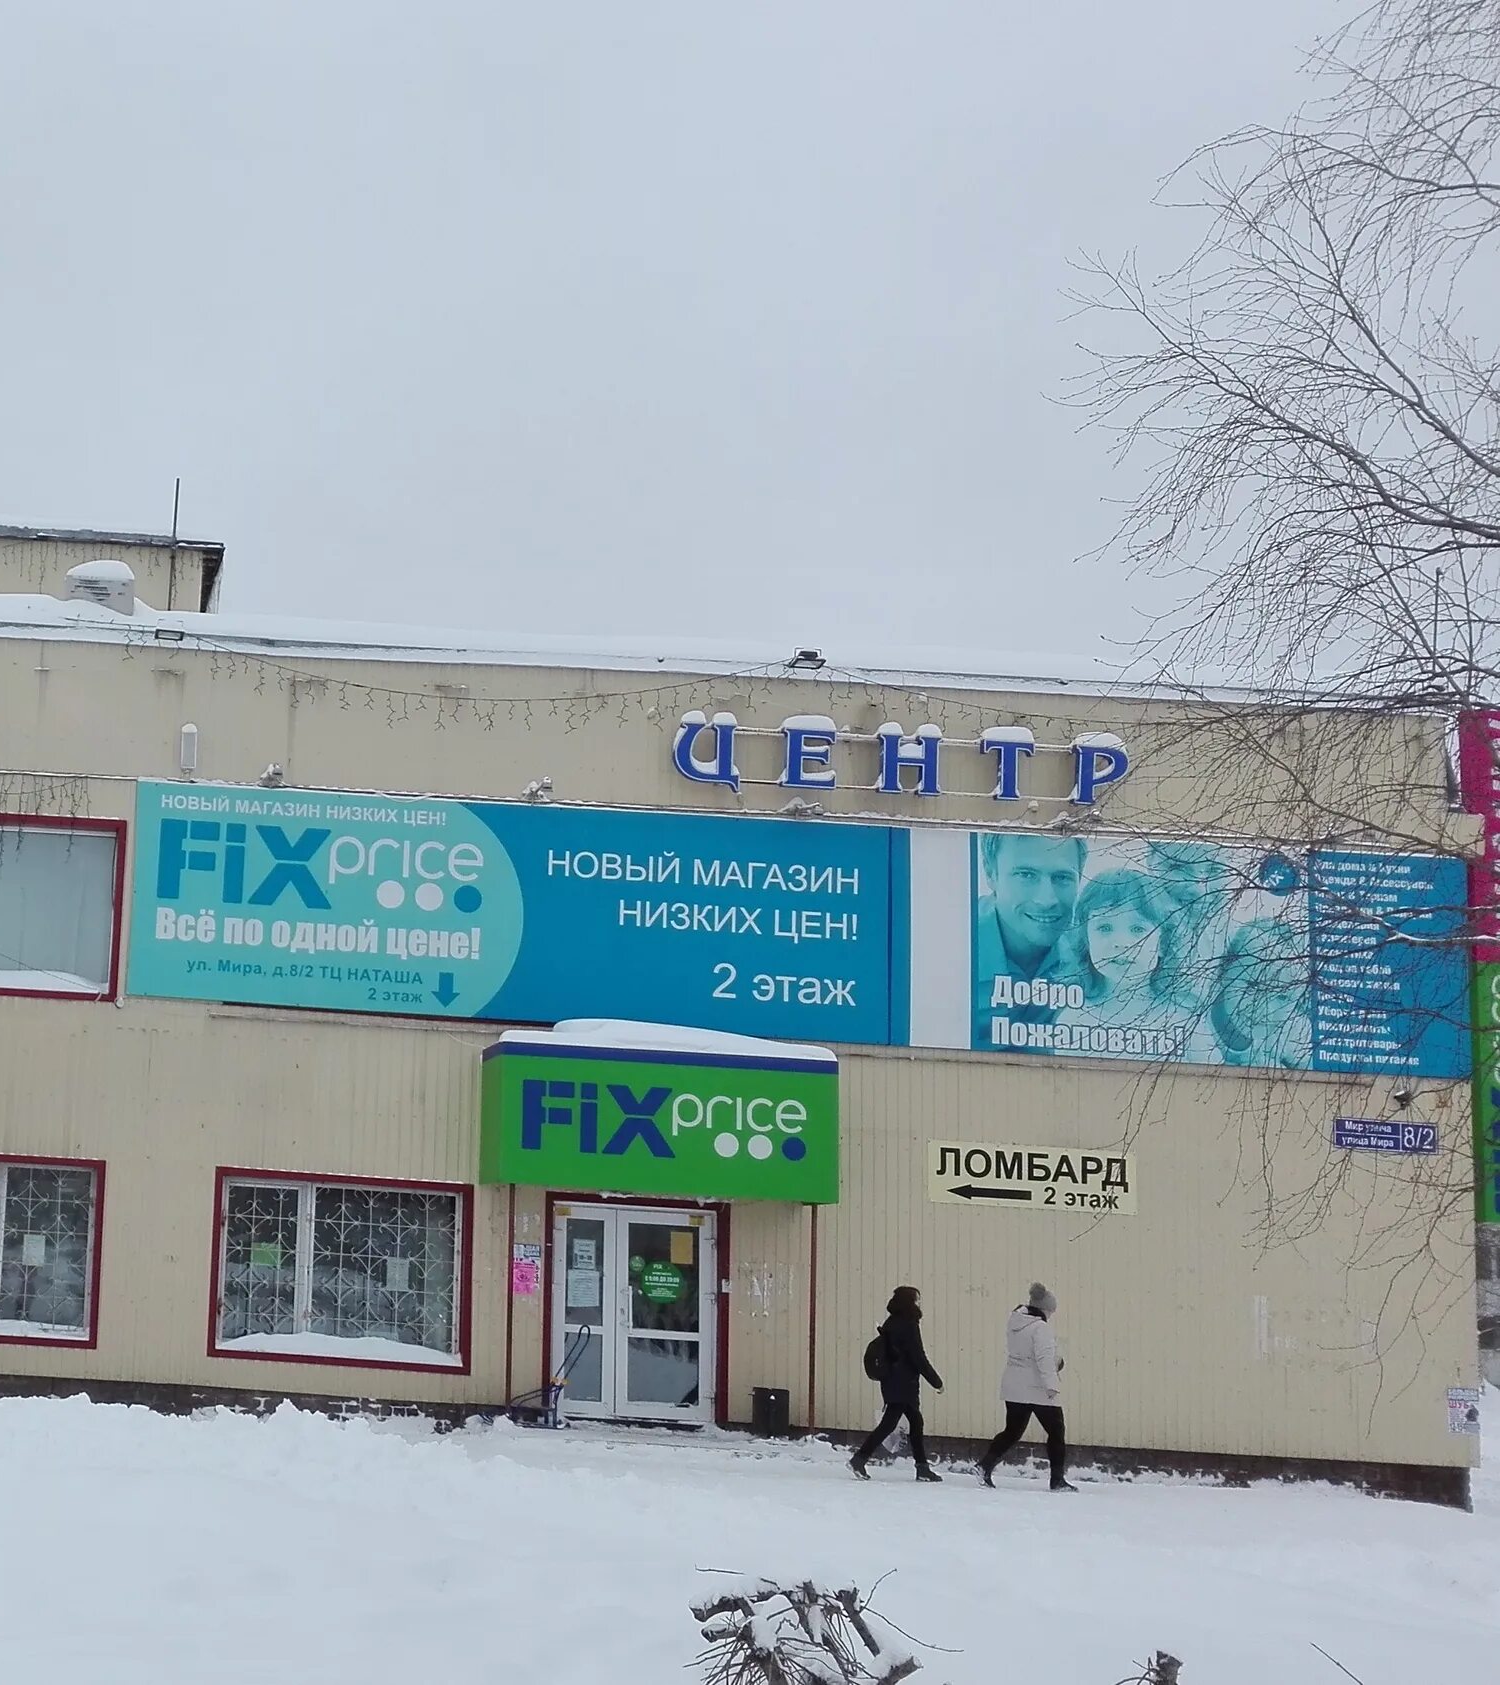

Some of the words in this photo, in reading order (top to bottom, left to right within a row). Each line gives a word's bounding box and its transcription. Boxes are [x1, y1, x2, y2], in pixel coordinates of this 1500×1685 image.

[673, 719, 1130, 804] ЦЕНТР
[161, 793, 229, 813] НОВЫЙ
[235, 799, 320, 818] МАГАЗИН
[326, 806, 398, 823] НИЗКИХ
[403, 809, 447, 827] ЦЕН!
[328, 835, 484, 885] price
[548, 849, 681, 884] НОВЫЙ
[693, 858, 860, 894] МАГАЗИН
[155, 907, 216, 943] Всё
[223, 916, 263, 946] по
[271, 919, 378, 953] одной
[386, 927, 482, 960] цене!
[618, 899, 762, 935] НИЗКИХ
[774, 909, 858, 944] ЦЕН!
[186, 958, 212, 973] ул.
[218, 959, 266, 976] Мира,
[272, 963, 313, 979] д.8/2
[319, 966, 343, 982] ТЦ
[347, 967, 423, 985] НАТАША
[712, 962, 737, 999] 2
[752, 974, 856, 1006] этаж
[990, 975, 1085, 1009] Добро
[367, 988, 377, 1000] 2
[383, 990, 423, 1003] этаж
[991, 1016, 1185, 1058] Пожаловать!
[671, 1093, 807, 1136] price
[1371, 1136, 1394, 1148] Мира
[1404, 1126, 1434, 1150] 8/2
[936, 1147, 1129, 1193] ЛОМБАРД
[1044, 1187, 1057, 1205] 2
[1064, 1192, 1119, 1209] этаж
